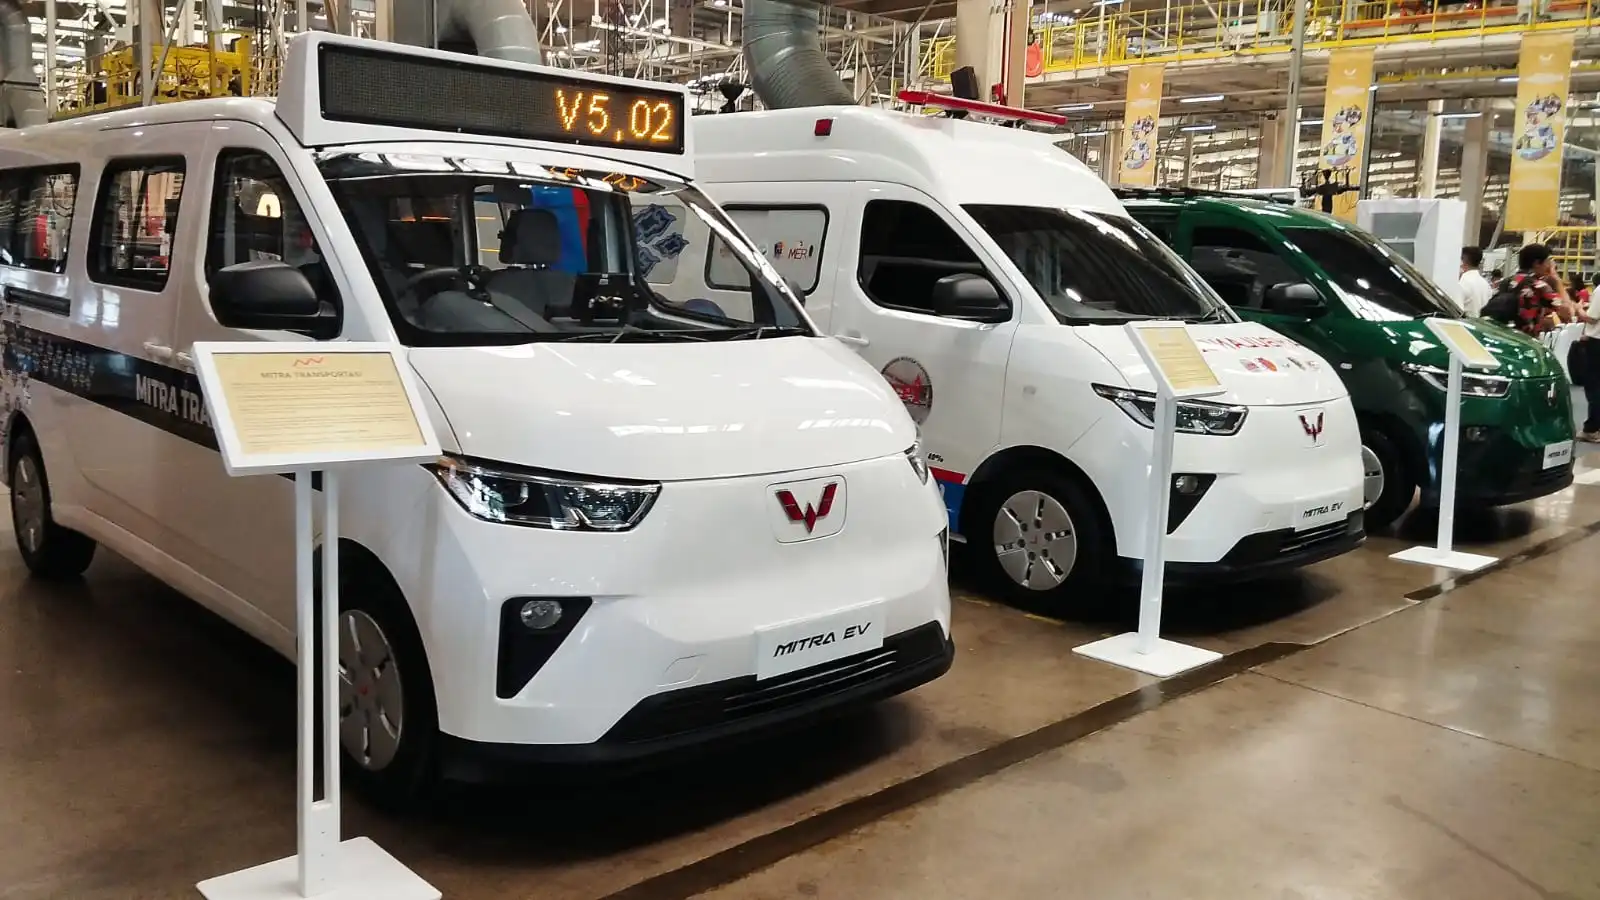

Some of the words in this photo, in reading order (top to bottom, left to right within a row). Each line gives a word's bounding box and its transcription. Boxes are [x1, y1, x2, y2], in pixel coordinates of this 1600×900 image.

[260, 371, 292, 379] MITRA
[294, 370, 363, 378] TRANSPORTASI
[136, 373, 178, 416] MITRA
[1302, 505, 1329, 519] MITRA
[1331, 501, 1344, 512] EV
[773, 631, 836, 658] MITRA
[843, 621, 872, 640] EV
